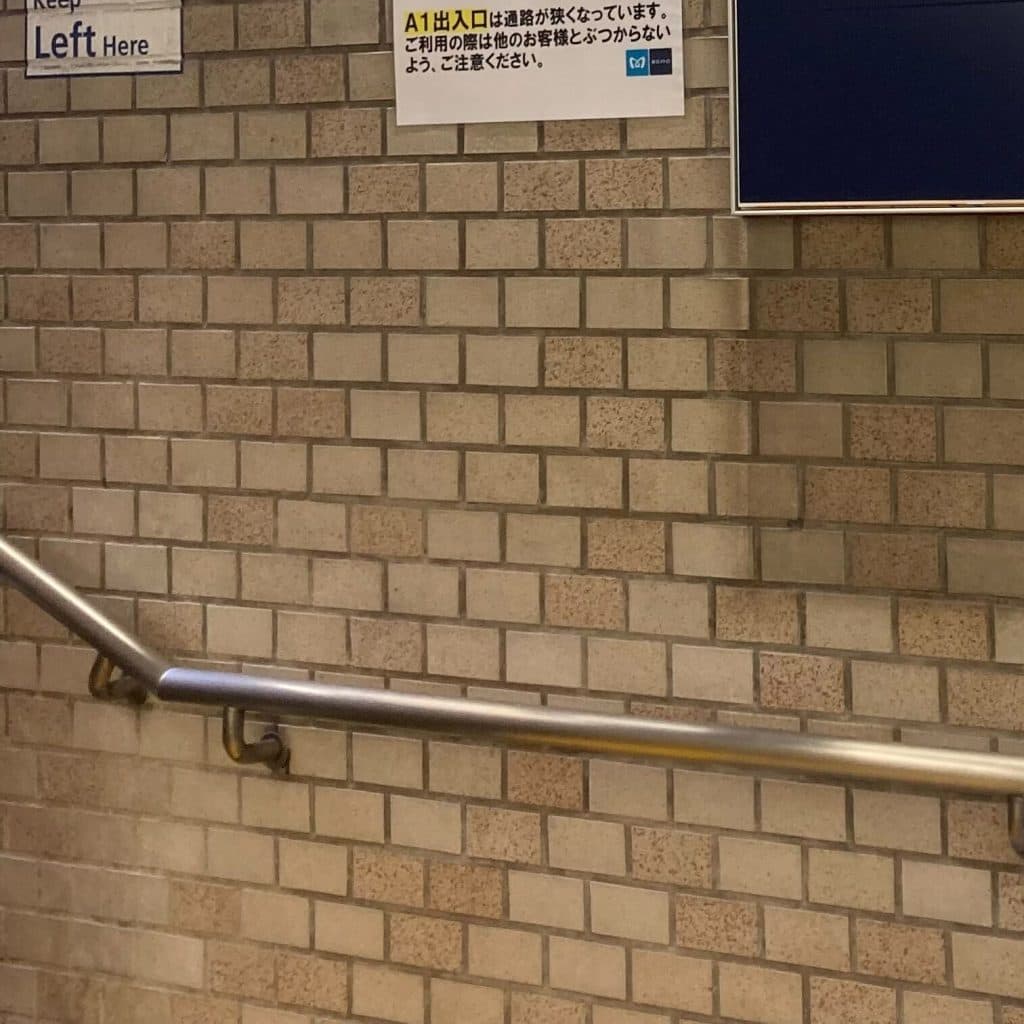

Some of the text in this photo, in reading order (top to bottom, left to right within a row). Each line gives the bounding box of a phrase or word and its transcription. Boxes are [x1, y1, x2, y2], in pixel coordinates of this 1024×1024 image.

[36, 21, 148, 59] Left Here
[406, 25, 670, 53] ご利用の際は他のお客様とぶつからない
[406, 52, 542, 73] よう、ご注意ください。
